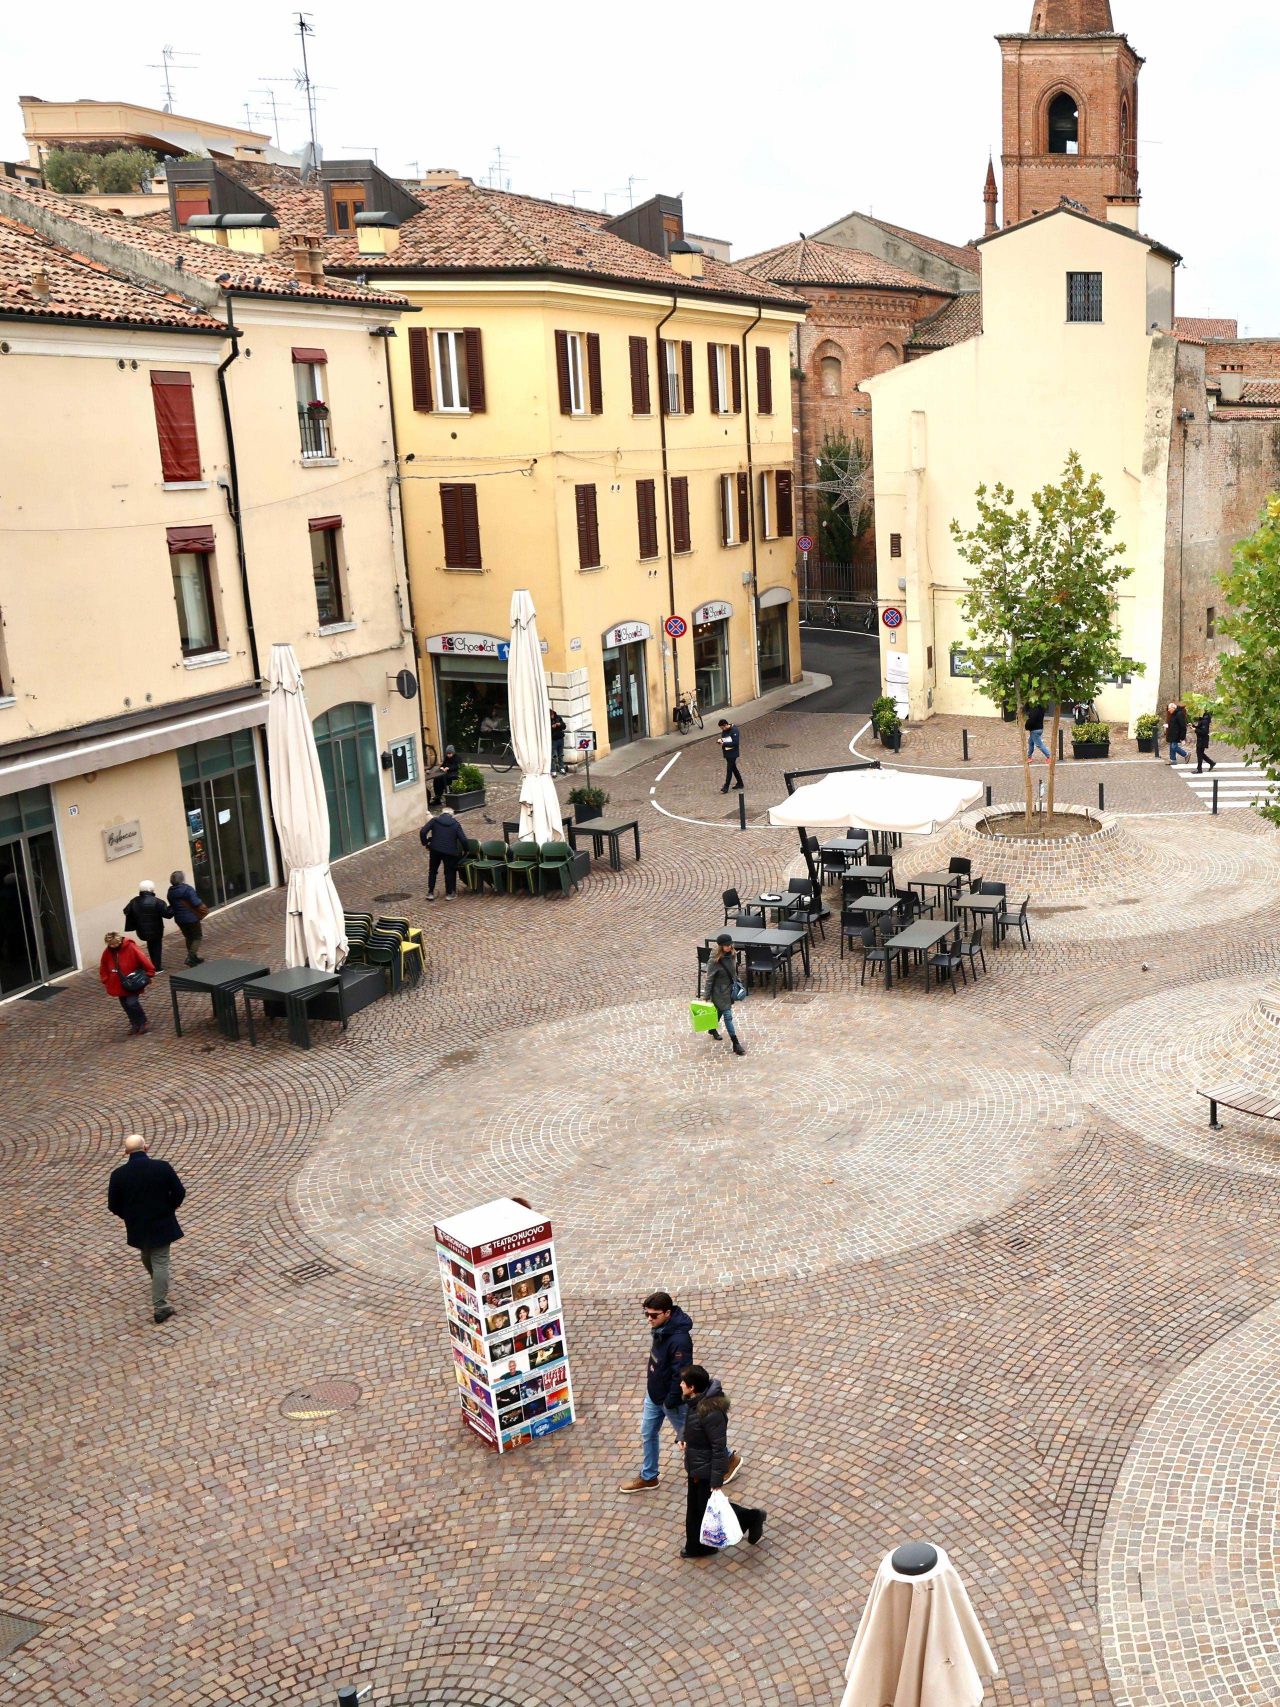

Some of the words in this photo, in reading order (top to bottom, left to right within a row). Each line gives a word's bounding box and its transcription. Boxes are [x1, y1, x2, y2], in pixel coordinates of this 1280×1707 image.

[621, 625, 643, 641] Chocolat
[454, 637, 496, 653] Chocolat
[492, 1234, 518, 1249] TEATRO
[518, 1225, 544, 1240] NUOVO
[502, 1236, 536, 1252] FERRARA
